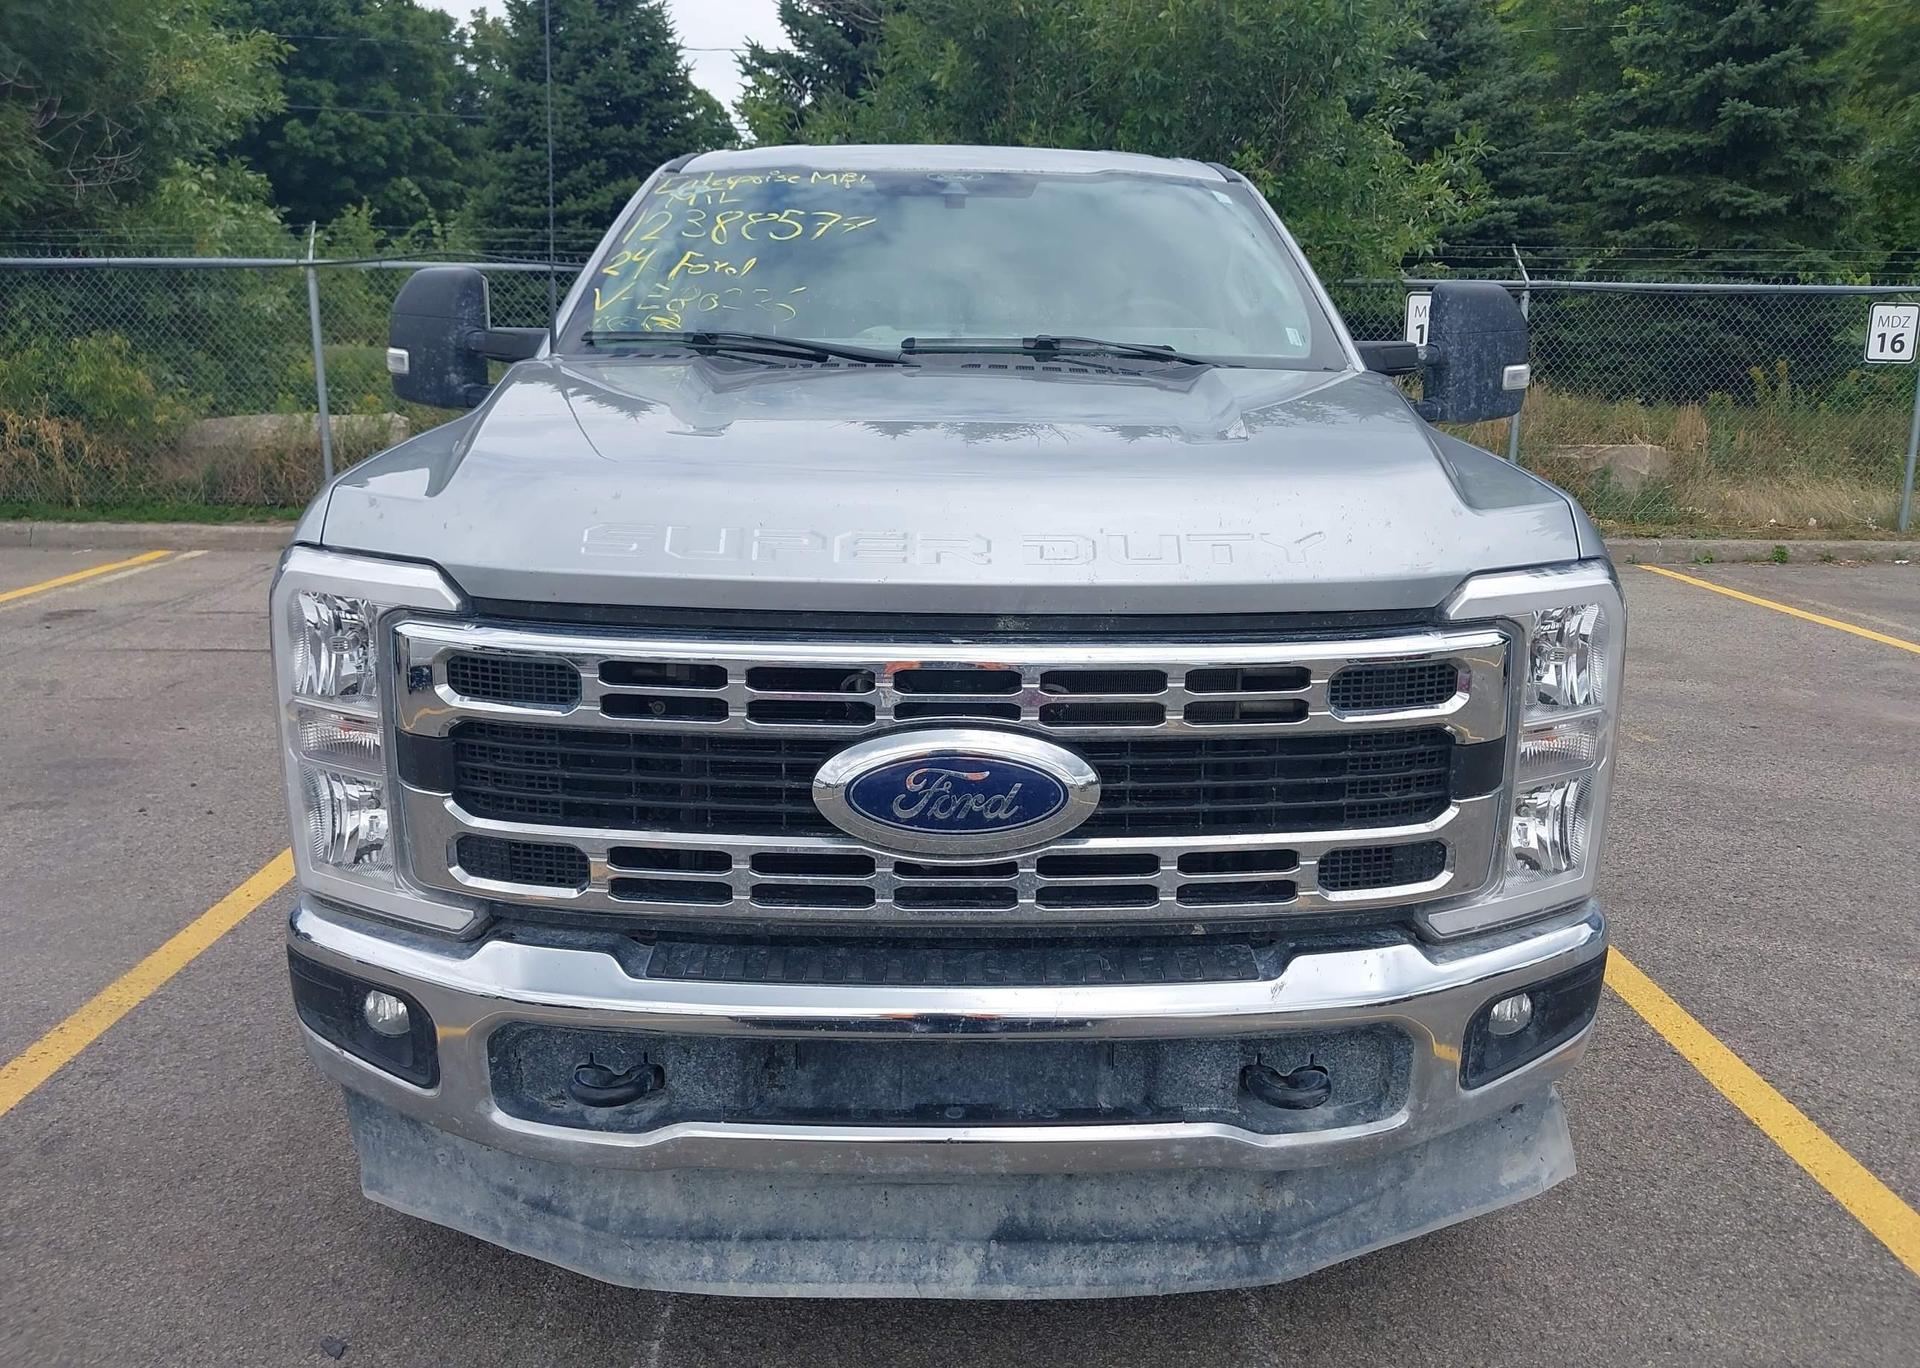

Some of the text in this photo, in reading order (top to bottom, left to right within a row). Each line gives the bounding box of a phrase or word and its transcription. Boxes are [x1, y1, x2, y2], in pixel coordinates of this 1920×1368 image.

[602, 248, 758, 281] 24 Ford
[1414, 305, 1427, 318] M
[1877, 315, 1911, 329] MDZ
[1415, 324, 1425, 344] 1
[1877, 332, 1905, 354] 16
[578, 521, 1327, 568] SUPER DUTY
[891, 767, 1023, 821] Ford
